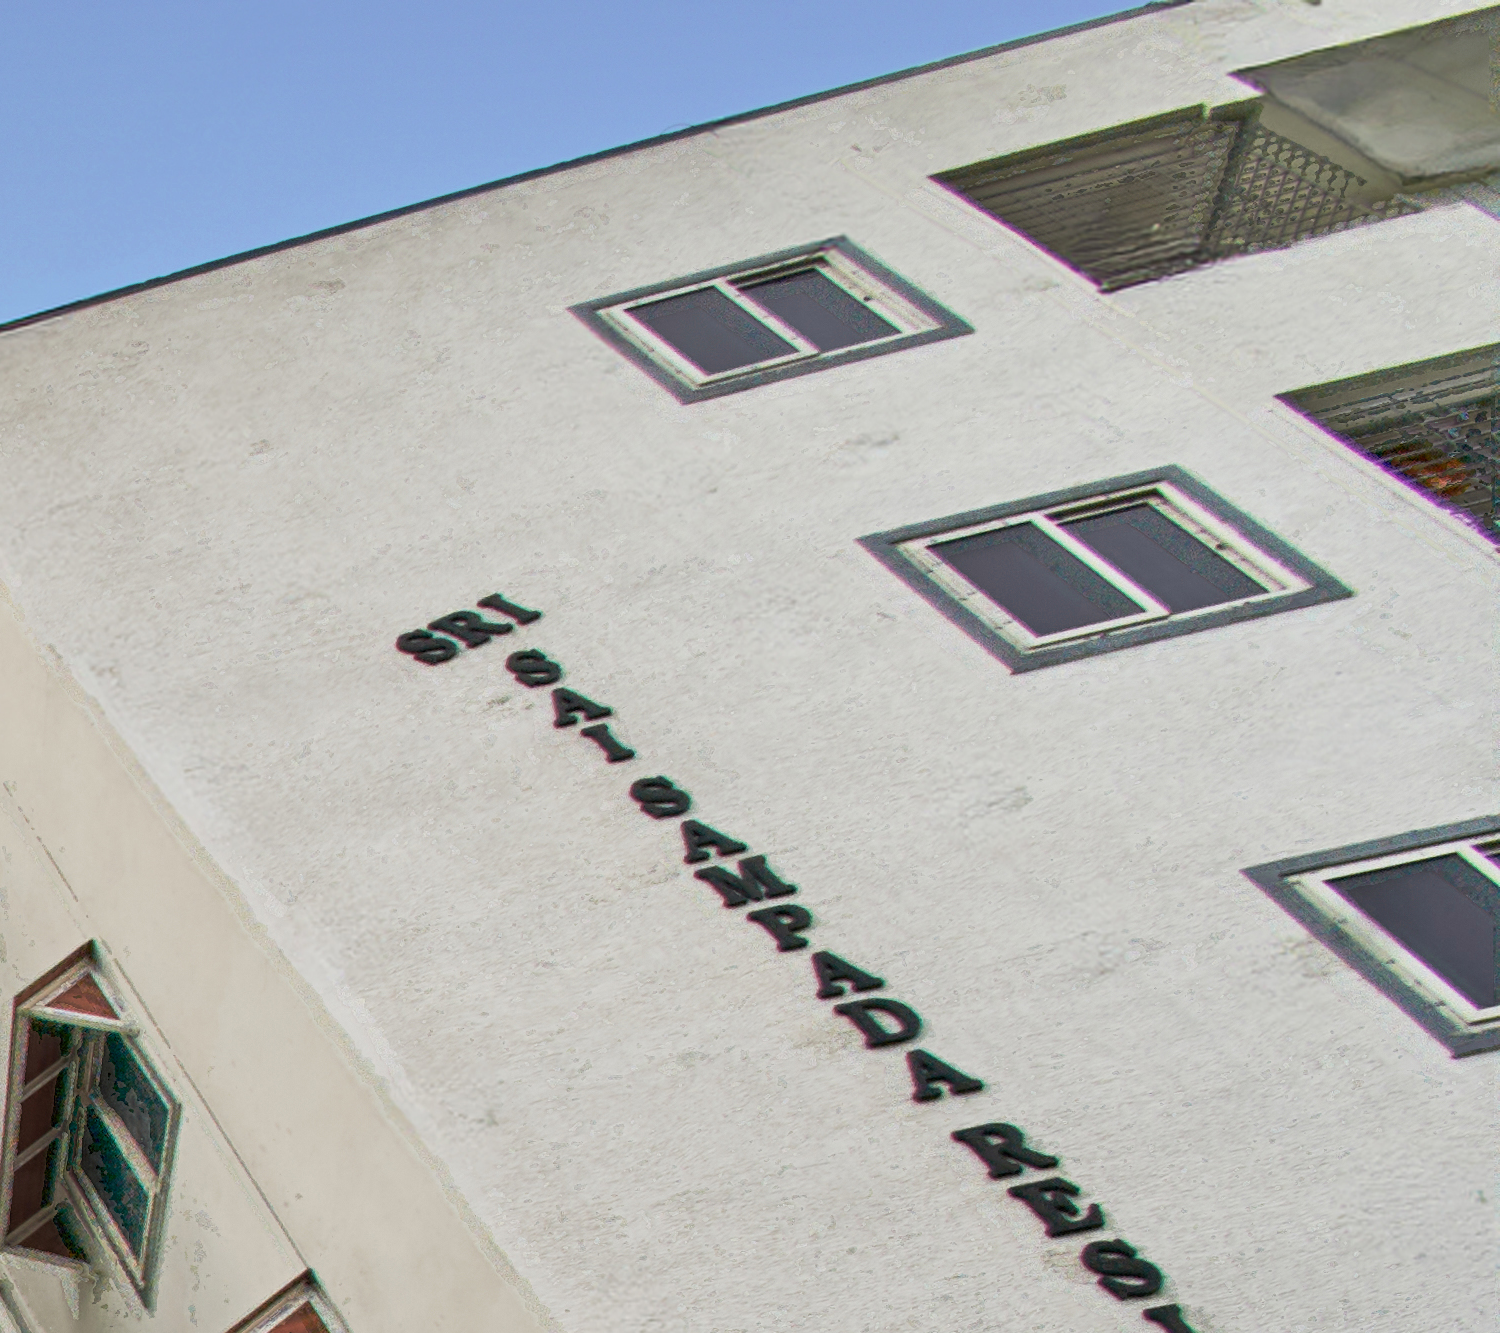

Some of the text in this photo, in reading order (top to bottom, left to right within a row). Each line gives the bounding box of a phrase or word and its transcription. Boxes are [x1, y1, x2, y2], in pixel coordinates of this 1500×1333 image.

[395, 593, 542, 667] SRI
[505, 648, 636, 764] SAI
[629, 775, 985, 1104] SAMPADA
